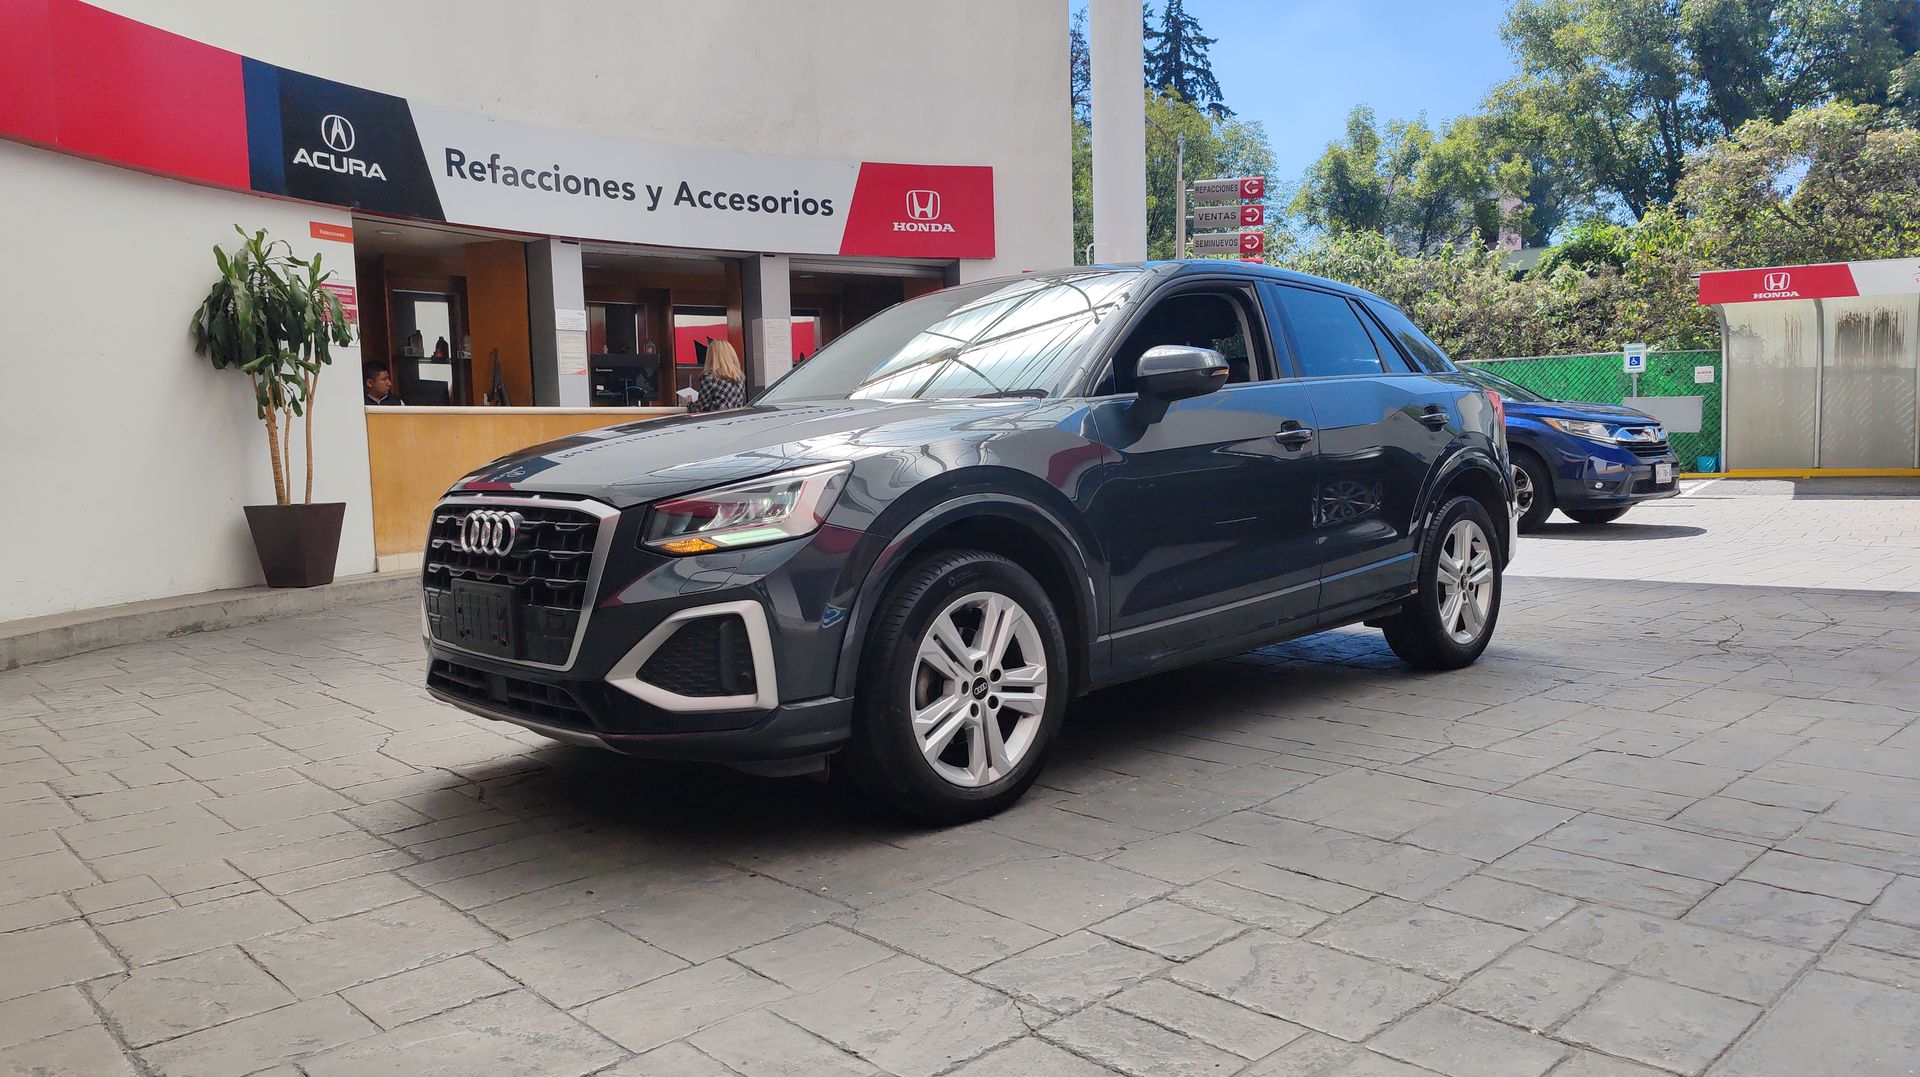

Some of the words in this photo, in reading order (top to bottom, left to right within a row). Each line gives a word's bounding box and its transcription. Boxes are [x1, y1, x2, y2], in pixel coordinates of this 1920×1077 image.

[293, 148, 387, 182] ACURA
[445, 147, 636, 201] Refacciones
[646, 184, 662, 211] y
[673, 181, 834, 216] Accesorios
[1195, 184, 1238, 194] REFACCIONES
[1198, 212, 1237, 221] VENTAS
[892, 222, 956, 233] HONDA
[1195, 239, 1238, 248] SEMINUEVOS
[1752, 291, 1800, 299] HONDA
